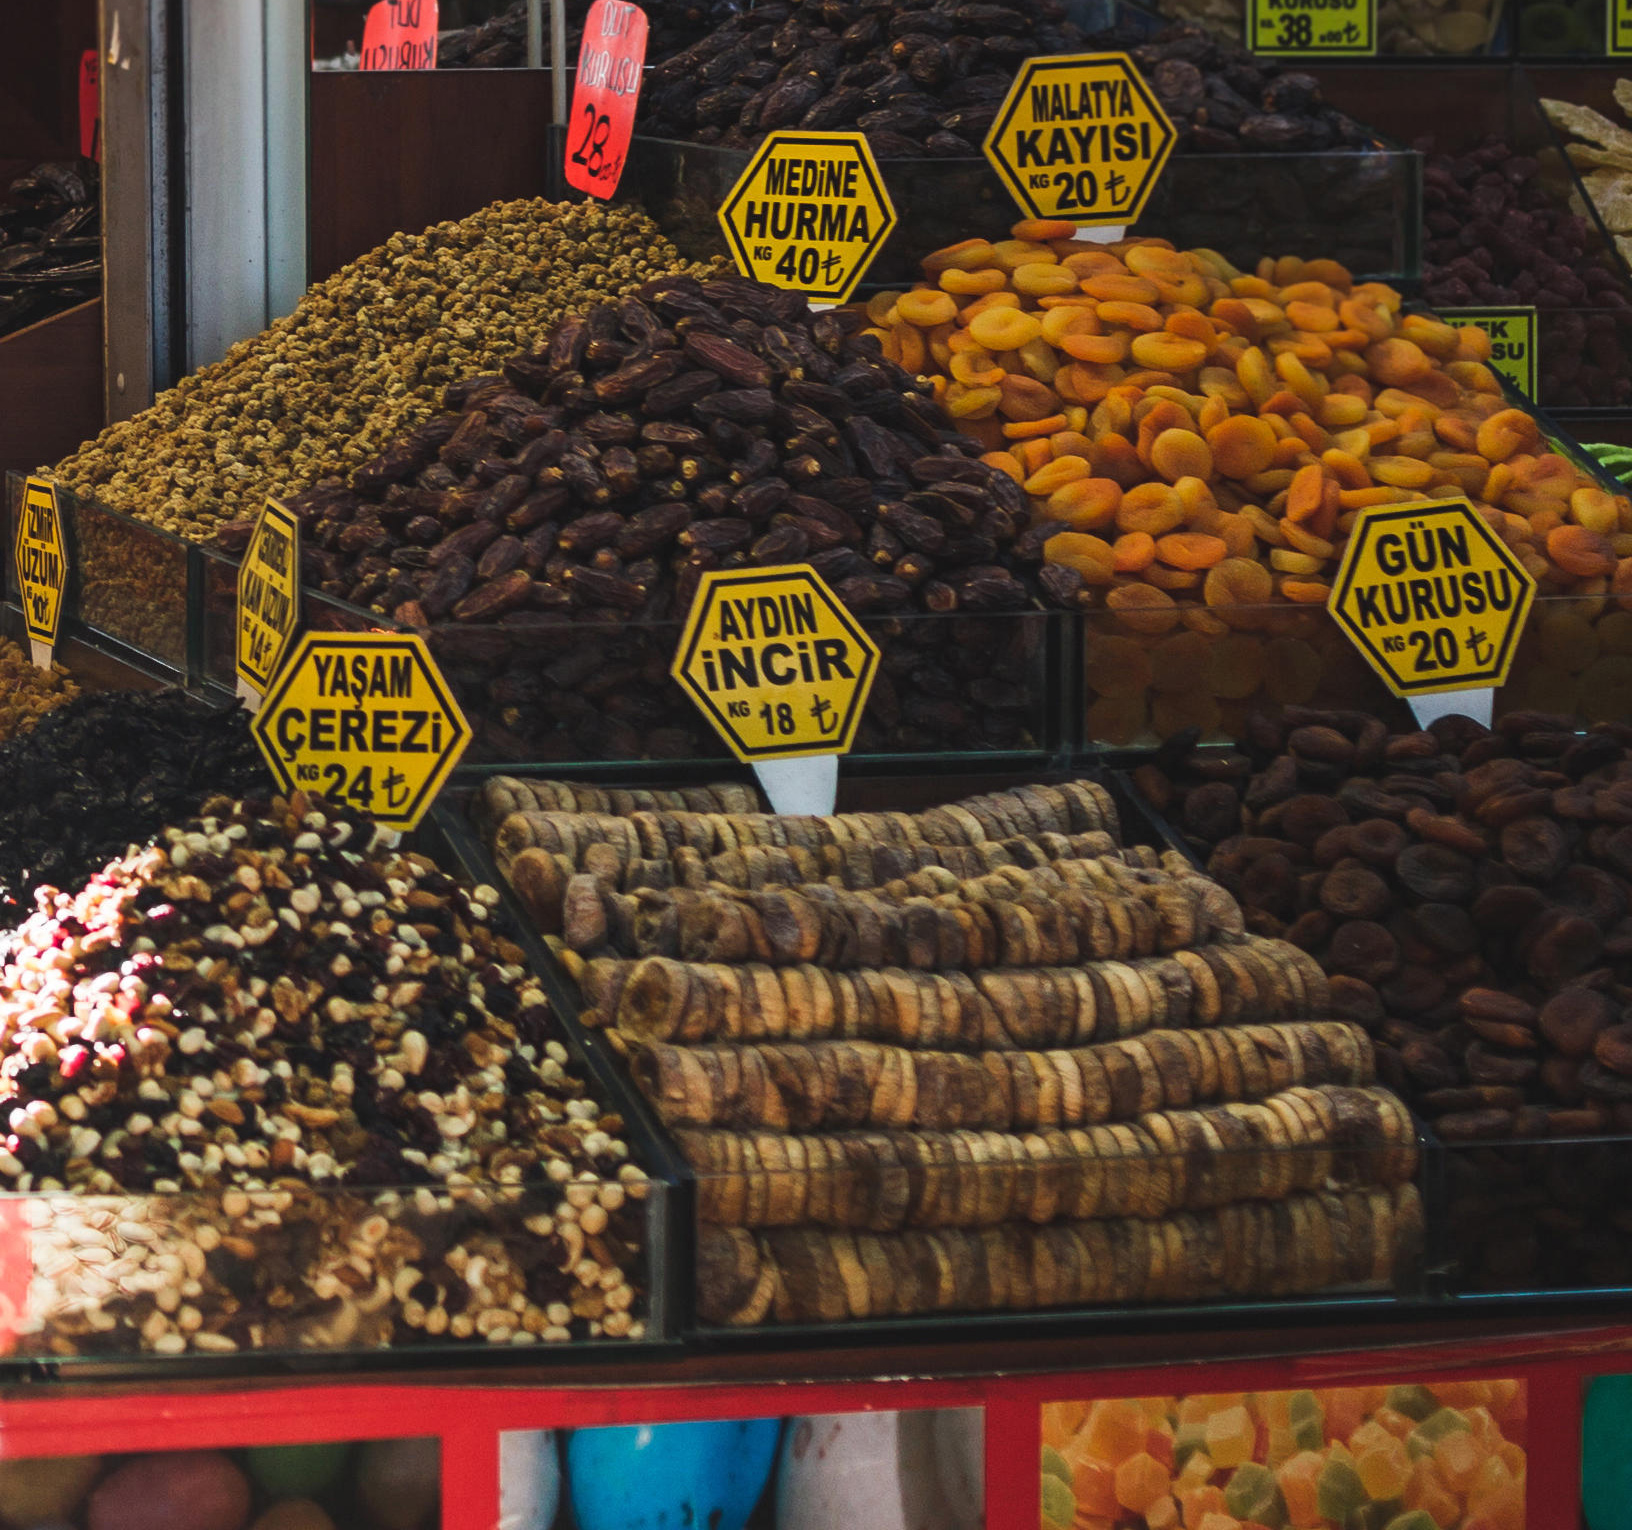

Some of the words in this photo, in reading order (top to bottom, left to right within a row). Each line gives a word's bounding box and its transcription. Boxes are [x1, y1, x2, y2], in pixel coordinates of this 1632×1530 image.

[601, 1, 635, 38] DUT
[1277, 13, 1313, 47] 38
[580, 43, 641, 97] KURUSU
[1031, 80, 1134, 122] MALATYA
[571, 103, 610, 178] 28
[1016, 122, 1151, 168] KAYISI
[1029, 174, 1050, 189] KG
[744, 201, 870, 243] HURMA
[753, 246, 773, 261] KG
[22, 538, 59, 590] ÜZÜM
[1375, 521, 1472, 576] GÜN
[719, 592, 818, 642] AYDIN
[1354, 568, 1512, 629] KURUSU
[1382, 635, 1406, 653] KG
[312, 654, 413, 709] YAŞAM
[727, 700, 750, 718] KG
[296, 763, 320, 781] KG
